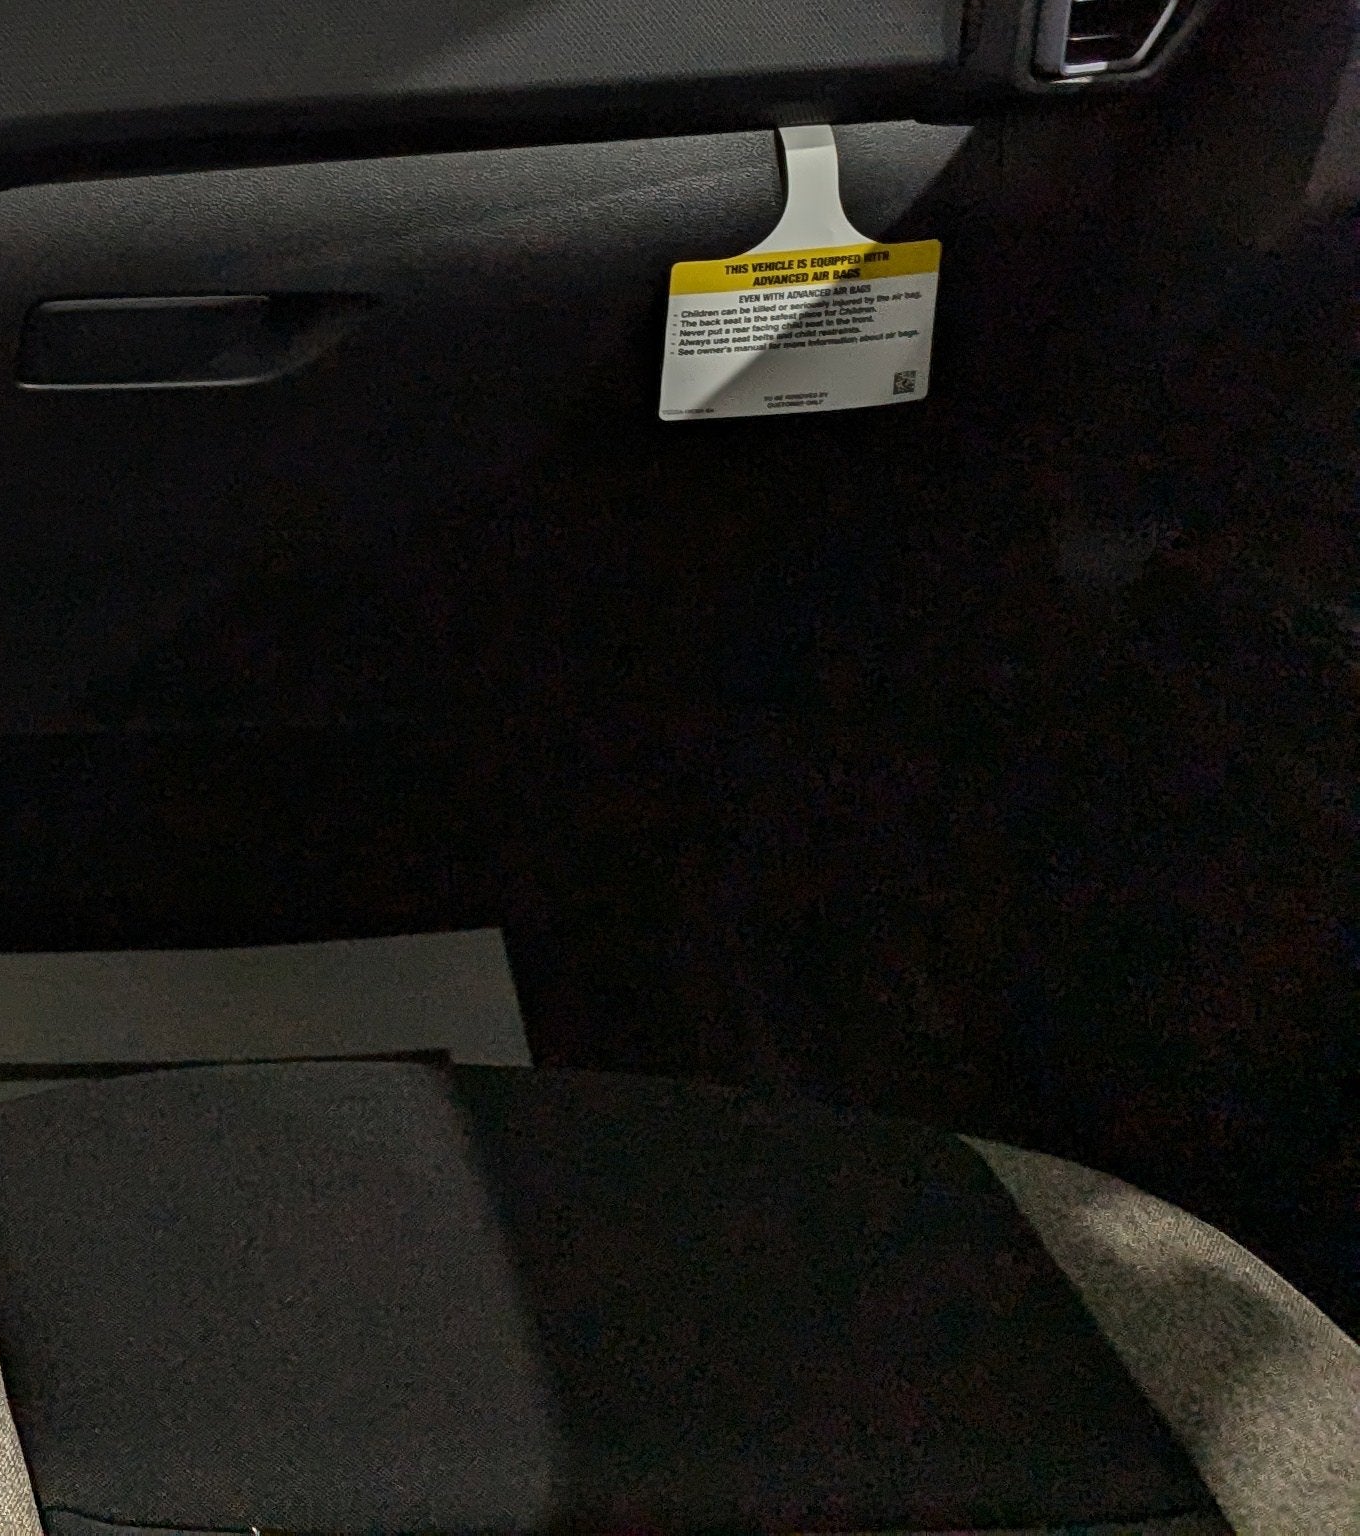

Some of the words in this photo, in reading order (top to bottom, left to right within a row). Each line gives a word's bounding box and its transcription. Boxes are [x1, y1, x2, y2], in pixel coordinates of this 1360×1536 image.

[725, 263, 749, 275] THIS
[752, 260, 794, 273] VEHICLE
[797, 258, 807, 269] IS
[810, 254, 861, 268] EQUIPPED
[753, 272, 808, 286] ADVANCED
[811, 270, 830, 282] AIR
[833, 268, 861, 280] BAGS
[739, 294, 761, 303] EVEN
[763, 292, 785, 302] WITH
[787, 288, 831, 300] ADVANCED
[681, 309, 719, 318] Children
[721, 308, 737, 316] can
[753, 305, 776, 313] killed
[680, 319, 697, 327] The
[700, 318, 721, 326] back
[680, 329, 706, 337] Never
[708, 328, 723, 336] put
[753, 324, 780, 332] facing
[678, 338, 711, 347] Always
[713, 337, 730, 345] use
[732, 335, 751, 343] seat
[678, 348, 695, 356] See
[697, 346, 732, 355] owner's
